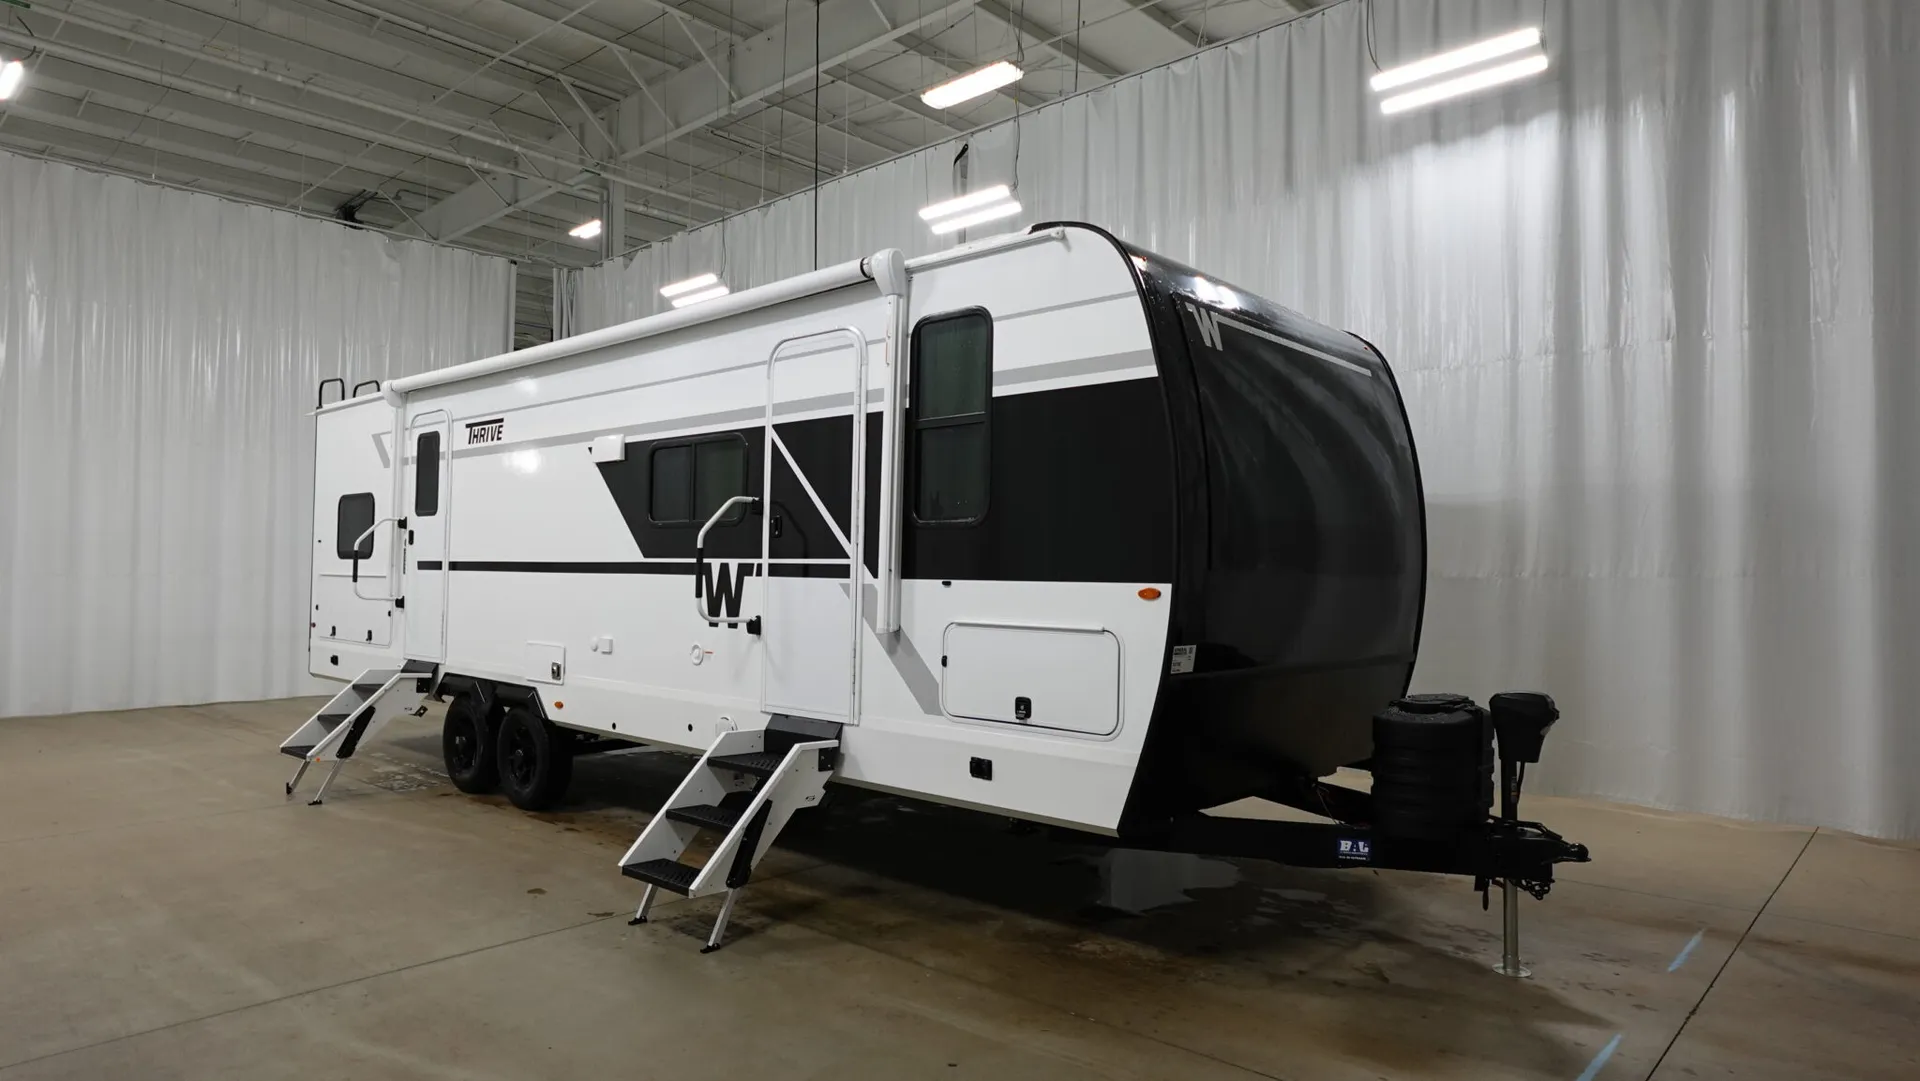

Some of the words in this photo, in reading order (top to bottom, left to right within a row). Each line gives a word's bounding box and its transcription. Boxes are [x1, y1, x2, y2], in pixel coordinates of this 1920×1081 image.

[1184, 301, 1223, 351] W
[465, 417, 504, 445] THRIVE
[703, 562, 755, 629] W
